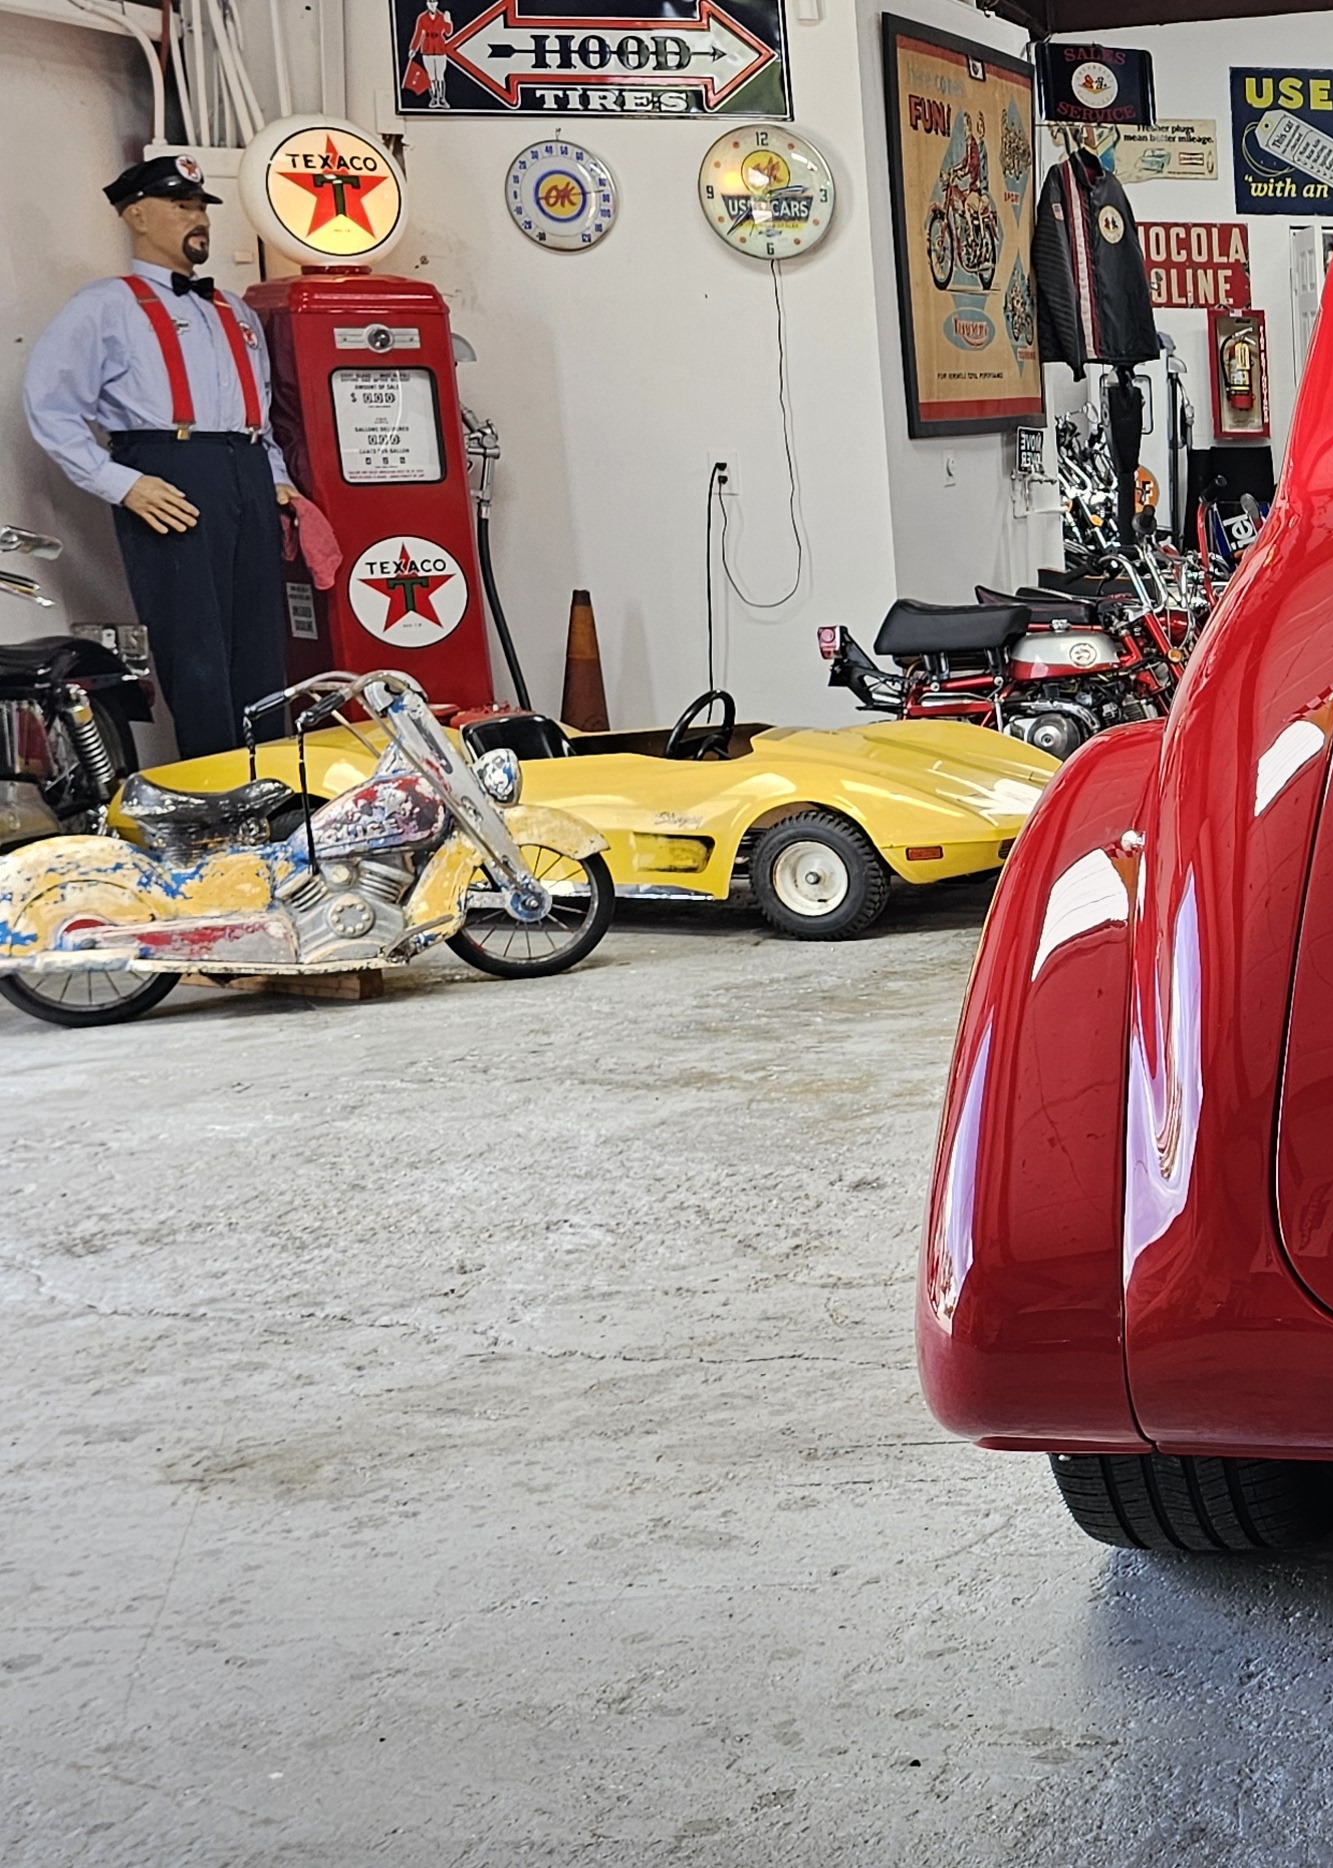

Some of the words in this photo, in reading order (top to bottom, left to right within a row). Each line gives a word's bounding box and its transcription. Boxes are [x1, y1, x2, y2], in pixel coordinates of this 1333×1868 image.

[529, 34, 691, 71] HOOD
[1063, 48, 1126, 65] SALES
[535, 88, 689, 112] TIRES
[909, 94, 951, 137] FUN!
[1056, 101, 1137, 123] SERVICE
[756, 131, 769, 146] 12
[285, 153, 378, 172] TEXACO
[706, 185, 714, 199] 9
[819, 188, 828, 203] 3
[1302, 182, 1329, 198] an
[771, 200, 809, 218] CARS
[365, 558, 446, 575] TEXACO
